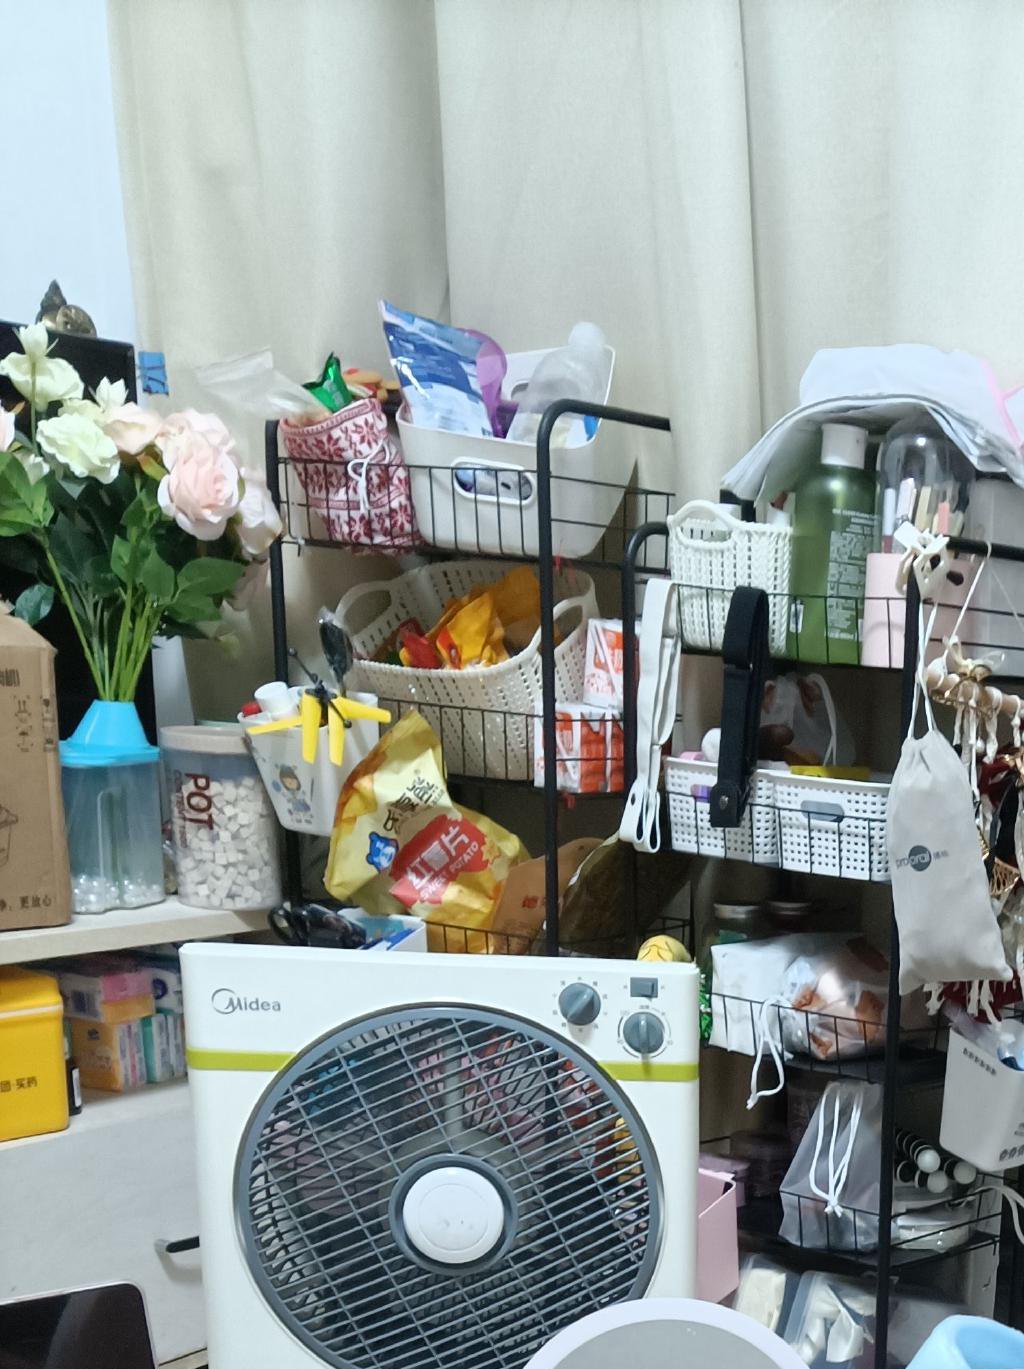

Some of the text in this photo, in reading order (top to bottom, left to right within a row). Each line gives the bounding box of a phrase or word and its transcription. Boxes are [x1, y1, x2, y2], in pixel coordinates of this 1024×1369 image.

[184, 772, 214, 830] POT
[448, 840, 479, 875] POTATO
[211, 987, 281, 1015] Midea
